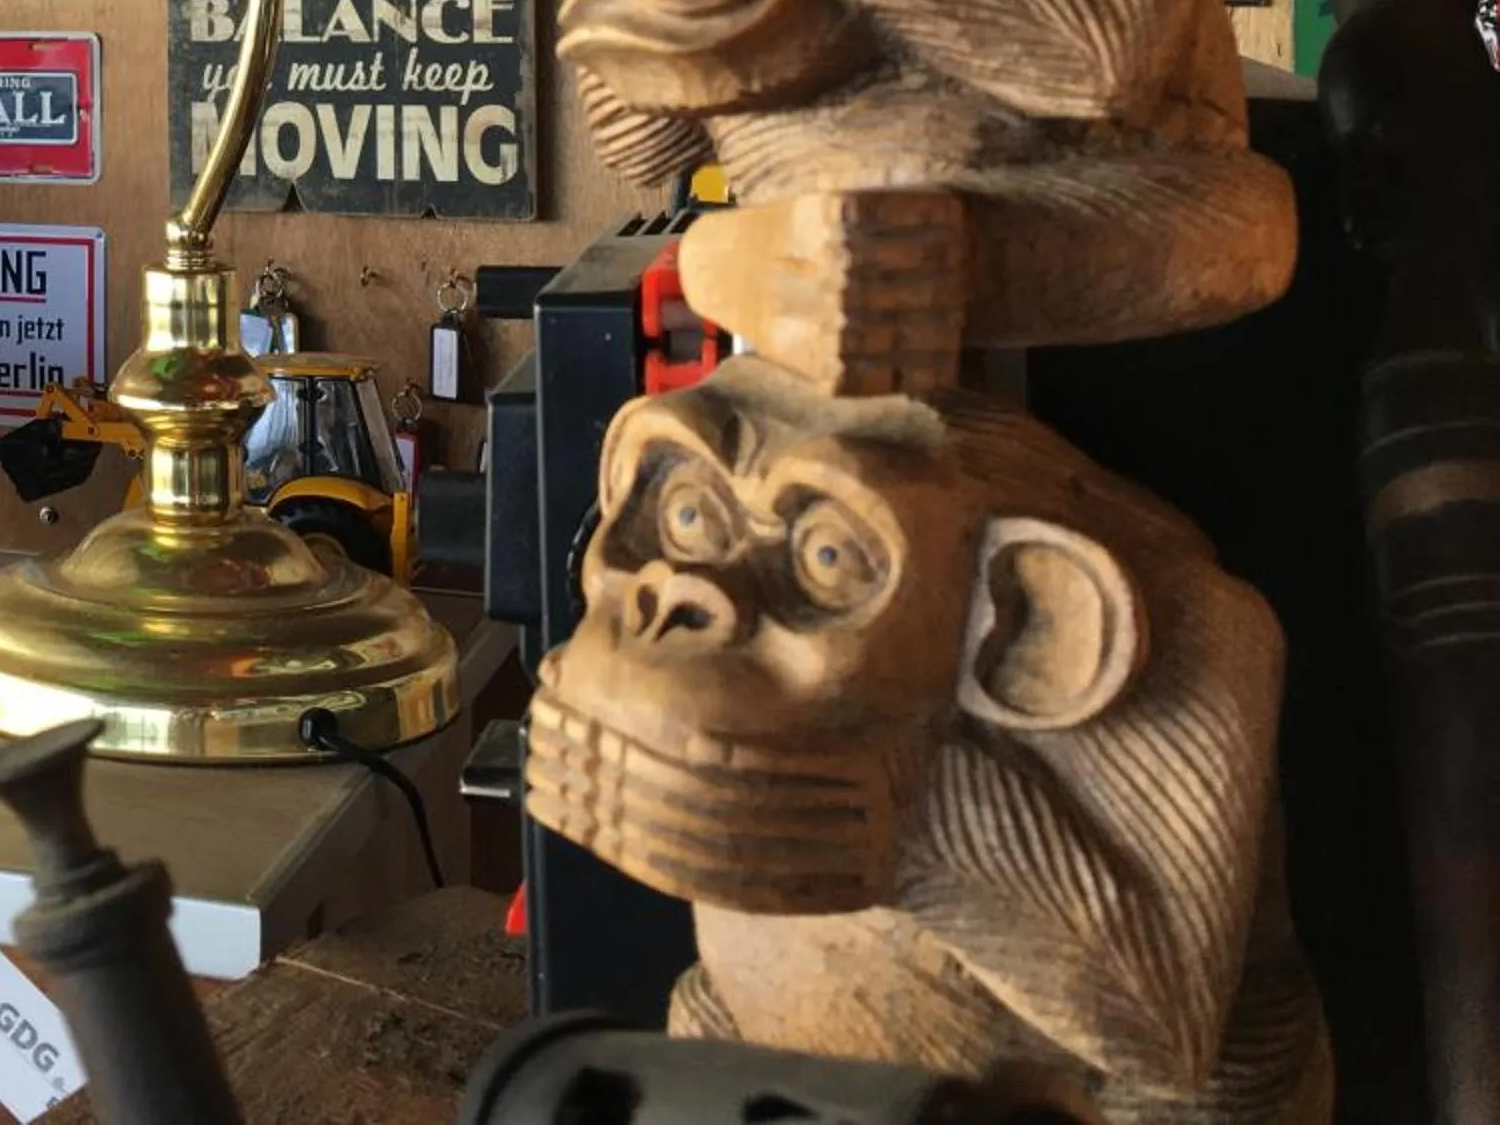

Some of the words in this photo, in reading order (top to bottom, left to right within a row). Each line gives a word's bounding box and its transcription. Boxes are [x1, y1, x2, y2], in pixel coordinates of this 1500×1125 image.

[287, 51, 388, 93] must
[402, 46, 496, 105] keep
[16, 315, 66, 346] jetzt
